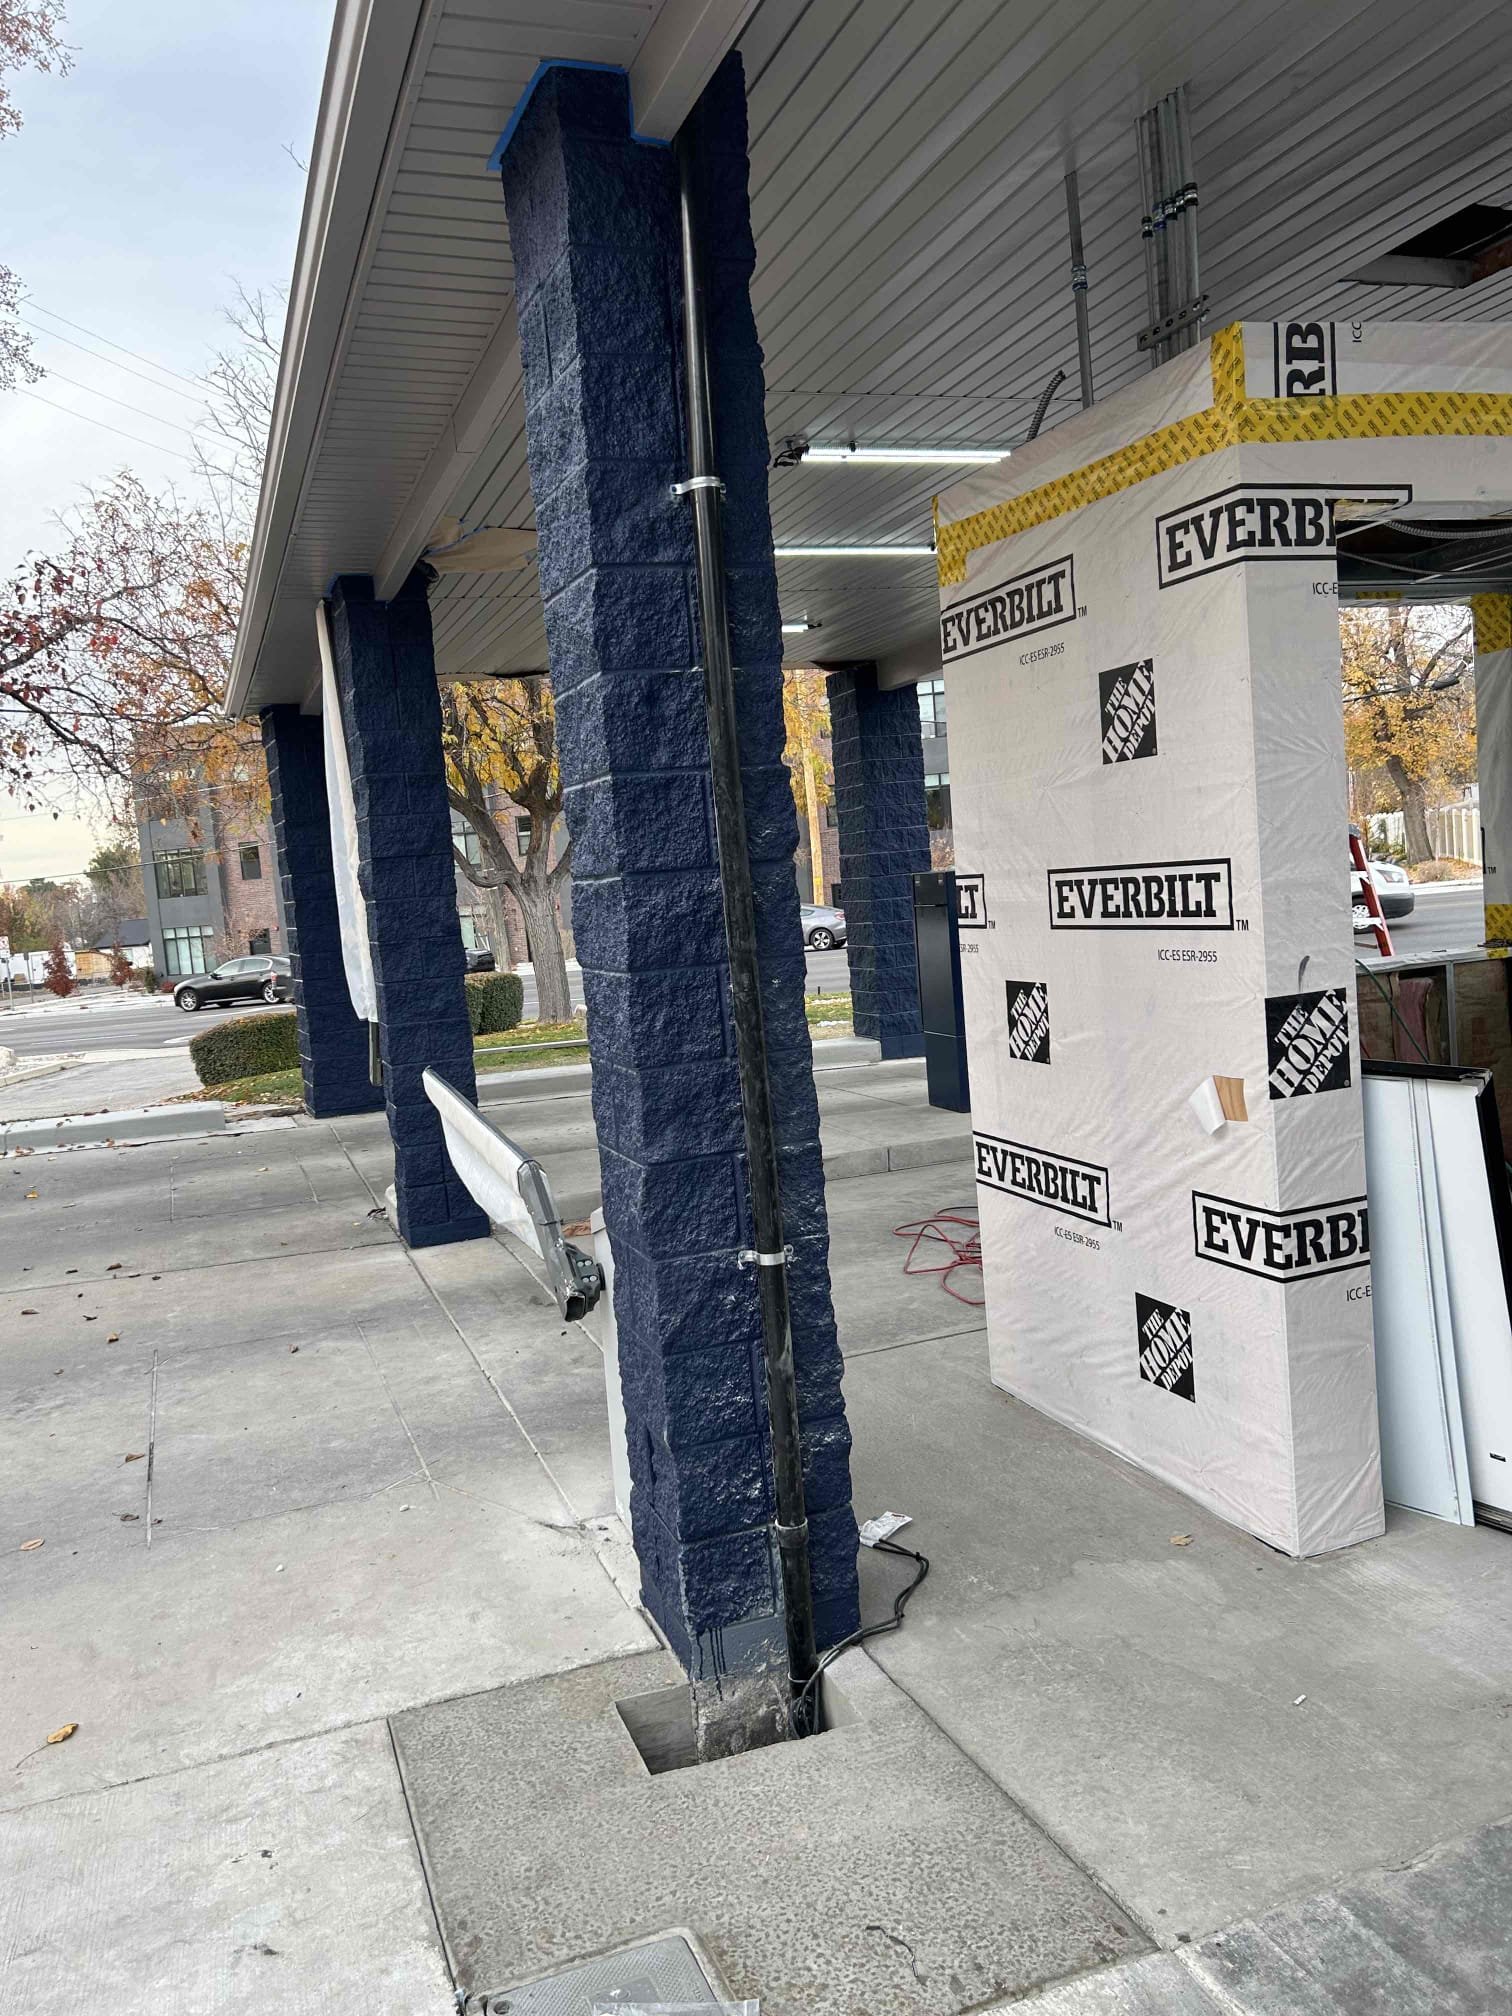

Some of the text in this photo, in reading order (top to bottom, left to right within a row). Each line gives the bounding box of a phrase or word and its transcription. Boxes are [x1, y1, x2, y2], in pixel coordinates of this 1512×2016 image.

[941, 569, 1088, 655] EVERBILT TM
[1037, 642, 1065, 660] ESR-2955
[1102, 660, 1153, 763] HOME
[1105, 677, 1127, 717] THE
[1123, 695, 1156, 760] DEPOT
[1055, 872, 1249, 931] EVERBILT TM
[1157, 949, 1218, 962] ICC-ES ESR-2955
[1009, 982, 1048, 1059] HOME
[1011, 989, 1028, 1020] THE
[1274, 1004, 1309, 1047] THE
[1024, 1012, 1049, 1061] DEPOT
[1269, 989, 1347, 1098] HOME
[1302, 1025, 1349, 1094] DEPOT
[976, 1141, 1123, 1232] EVERBILT TM
[1072, 1232, 1101, 1250] ESR-2955
[1139, 1307, 1191, 1383] HOME
[1142, 1308, 1164, 1340] THE
[1160, 1344, 1193, 1391] DEPOT
